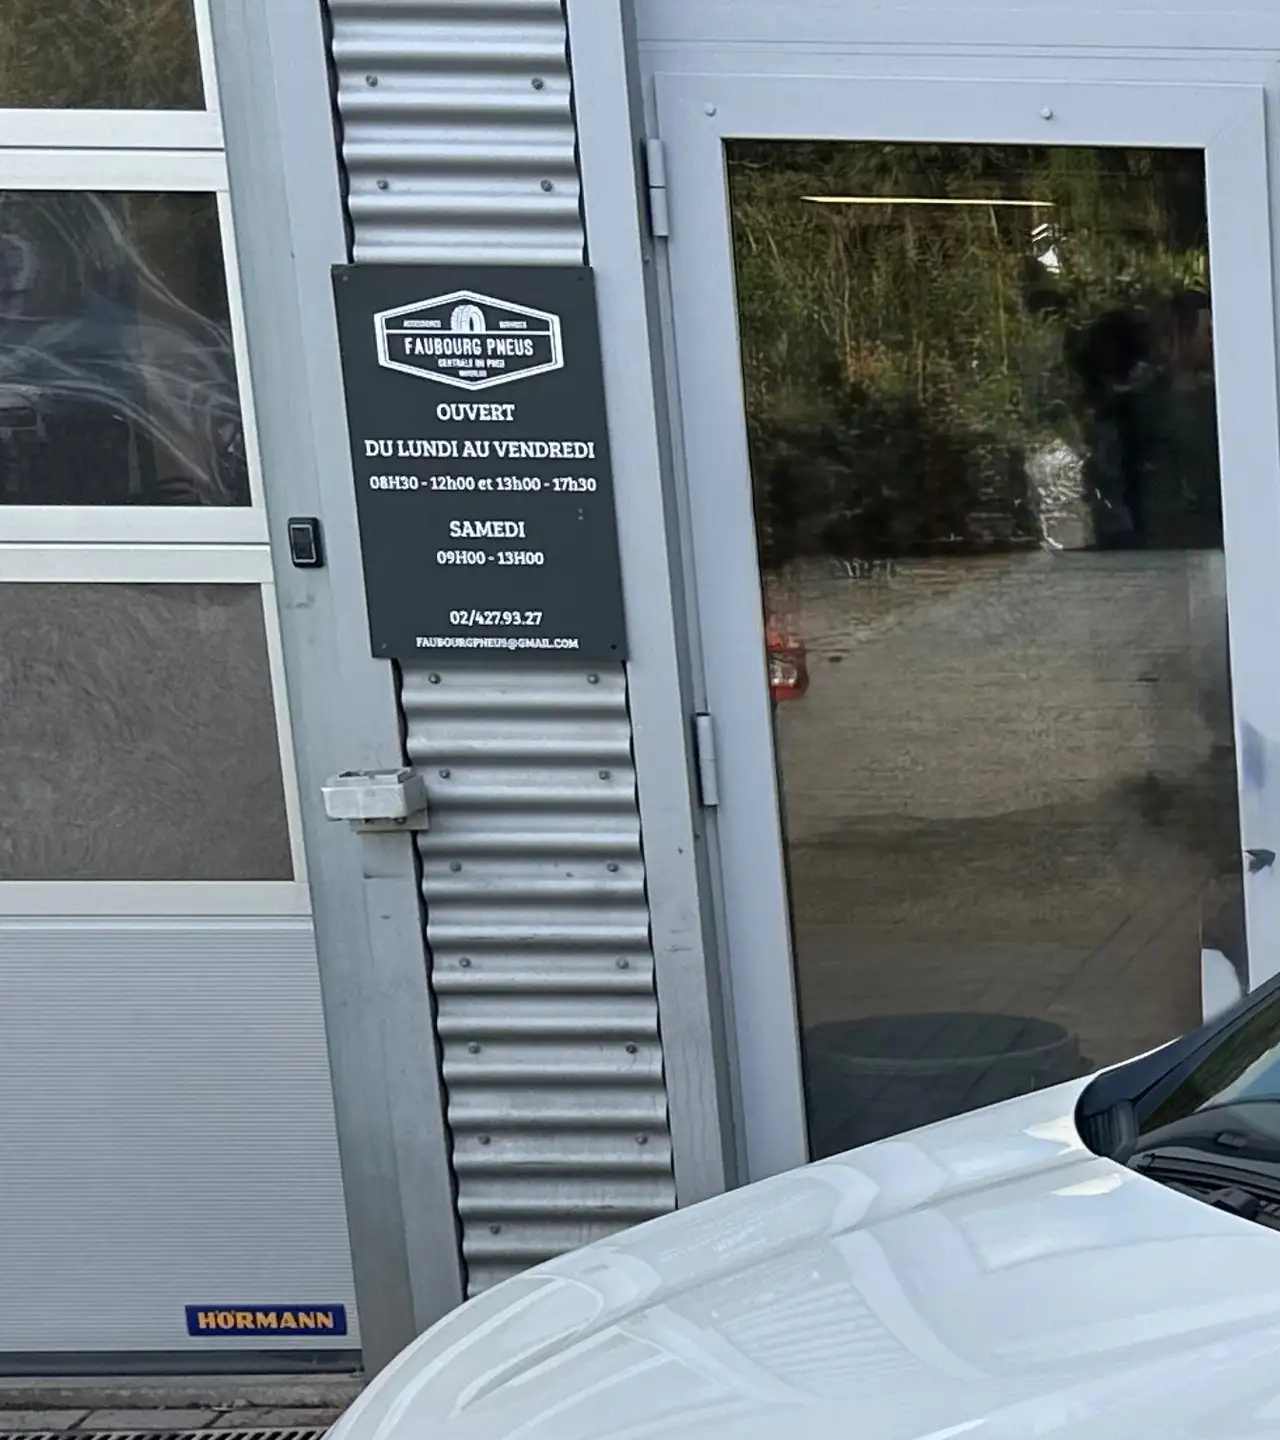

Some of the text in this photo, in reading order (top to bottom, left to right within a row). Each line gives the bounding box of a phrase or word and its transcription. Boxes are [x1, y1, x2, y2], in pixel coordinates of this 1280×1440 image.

[404, 337, 534, 356] FAUBOURG PNEUS
[436, 403, 516, 421] OUVERT
[364, 439, 595, 459] DU LUNDI AU VENDREDI
[369, 475, 419, 490] 08H30
[430, 476, 475, 491] 12h00
[478, 478, 493, 491] et
[496, 476, 541, 492] 13h00
[552, 478, 597, 492] 17h30
[449, 520, 526, 538] SAMEDI
[436, 550, 486, 565] 09H00
[497, 551, 544, 565] 13H00
[449, 609, 543, 626] 02/427.93.27
[197, 1310, 334, 1329] HÖRMANN
